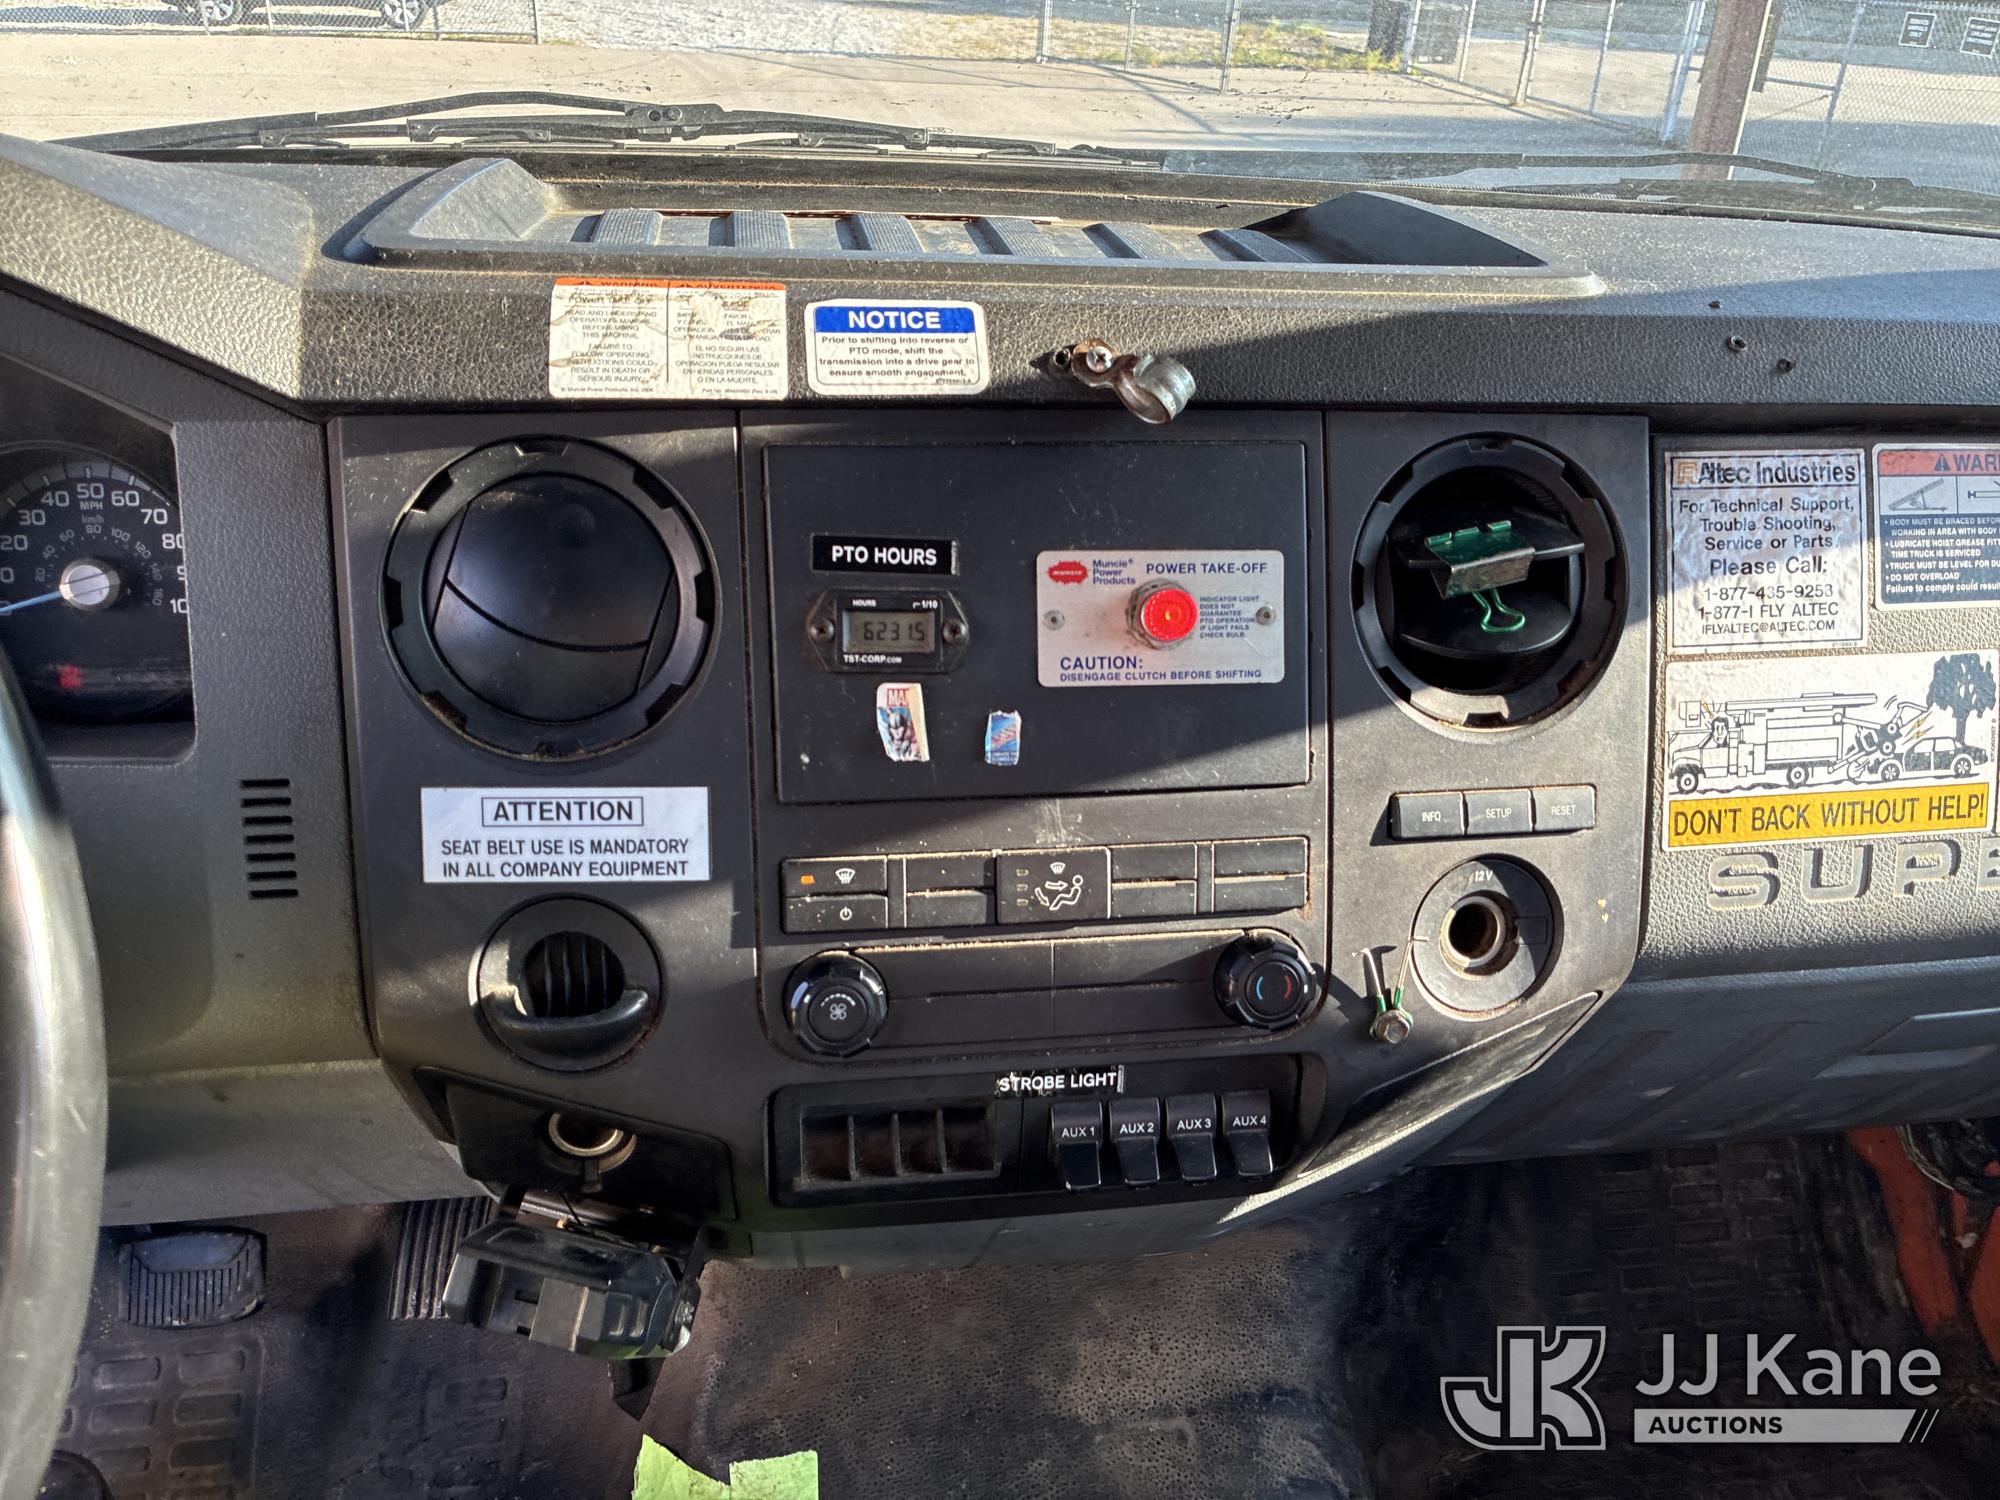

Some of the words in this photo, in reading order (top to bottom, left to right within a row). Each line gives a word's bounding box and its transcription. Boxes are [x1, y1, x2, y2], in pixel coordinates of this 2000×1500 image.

[848, 311, 940, 329] NOTICE
[822, 336, 845, 344] Prior
[848, 336, 857, 344] to
[860, 336, 897, 345] shifting
[899, 336, 918, 344] into
[872, 347, 902, 356] mode,
[819, 357, 883, 365] transmission
[885, 357, 903, 365] into
[942, 358, 962, 367] gear
[1953, 453, 2000, 472] WAR
[1698, 461, 1751, 484] Altec
[1756, 460, 1856, 484] Industries
[40, 490, 70, 507] 40
[76, 483, 105, 499] 50
[111, 490, 140, 507] 60
[80, 501, 103, 511] MPH
[1679, 499, 1703, 514] For
[1710, 497, 1783, 513] Technical
[1791, 497, 1855, 514] Support,
[18, 509, 46, 526] 30
[140, 508, 168, 525] 70
[1700, 516, 1756, 532] Trouble
[1763, 515, 1836, 533] Shooting,
[1890, 518, 1909, 526] BODY
[1945, 517, 1975, 525] BRACED
[58, 528, 76, 543] 60
[85, 524, 102, 534] 80
[110, 527, 131, 542] 100
[1891, 528, 1926, 536] WORKING
[1928, 528, 1935, 536] IN
[1958, 527, 1976, 535] WITH
[1978, 527, 1997, 535] BODY
[0, 534, 29, 551] 20
[133, 540, 152, 559] 120
[1704, 536, 1764, 550] Service
[1770, 537, 1787, 549] or
[1793, 534, 1833, 549] Parts
[1890, 540, 1930, 548] LUBRICATE
[1932, 539, 1954, 547] HOIST
[1957, 539, 1985, 547] GREASE
[831, 545, 869, 564] PTO
[874, 547, 937, 566] HOURS
[1910, 550, 1934, 558] TRUCK
[1945, 549, 1980, 557] SERVICED
[1092, 568, 1123, 577] Power
[1146, 562, 1196, 574] POWER
[1201, 562, 1268, 574] TAKE-OFF
[1709, 557, 1776, 577] Please
[1785, 555, 1828, 574] Call:
[1890, 562, 1914, 570] TRUCK
[1916, 561, 1937, 569] MUST
[1939, 561, 1948, 569] BE
[1975, 560, 1989, 568] FOR
[1092, 577, 1136, 586] Products
[1903, 573, 1918, 581] NOT
[1920, 572, 1959, 580] OVERLOAD
[1704, 584, 1833, 600] 1-877-435-9253
[1886, 584, 1913, 593] Failure
[1915, 584, 1923, 592] to
[1925, 583, 1954, 594] comply
[1956, 582, 1978, 591] could
[852, 599, 877, 607] HOURS
[922, 600, 938, 609] 1/10
[1760, 604, 1785, 618] FLY
[1792, 602, 1839, 616] ALTEC
[1702, 620, 1835, 634] IFLYALTEC@ALTEC.COM
[1060, 656, 1143, 671] CAUTION:
[1060, 671, 1121, 682] DISENGAGE
[1125, 671, 1167, 681] CLUTCH
[1171, 670, 1211, 680] BEFORE
[1215, 669, 1262, 679] SHIFTING
[493, 800, 633, 822] ATTENTION
[1421, 810, 1442, 823] INFO
[1485, 807, 1512, 819] SETUP
[1551, 804, 1577, 816] RESET
[1673, 807, 1741, 837] DON'T
[1750, 804, 1811, 832] BACK
[1821, 797, 1920, 827] WITHOUT
[1927, 793, 1985, 822] HELP!
[441, 839, 481, 855] SEAT
[487, 839, 526, 855] BELT
[531, 839, 564, 855] USE
[568, 839, 585, 855] IS
[590, 838, 689, 855] MANDATORY
[442, 862, 460, 877] IN
[465, 862, 495, 877] ALL
[500, 861, 583, 877] COMPANY
[589, 860, 689, 877] EQUIPMENT
[999, 1074, 1065, 1092] STROBE
[1070, 1072, 1118, 1089] LIGHT
[1119, 1123, 1146, 1134] AUX
[1147, 1122, 1154, 1133] 2
[1176, 1118, 1203, 1130] AUX
[1204, 1118, 1212, 1129] 3
[1232, 1116, 1258, 1128] AUX
[1260, 1114, 1267, 1126] 4
[1061, 1126, 1088, 1138] AUX
[1090, 1126, 1095, 1137] 1
